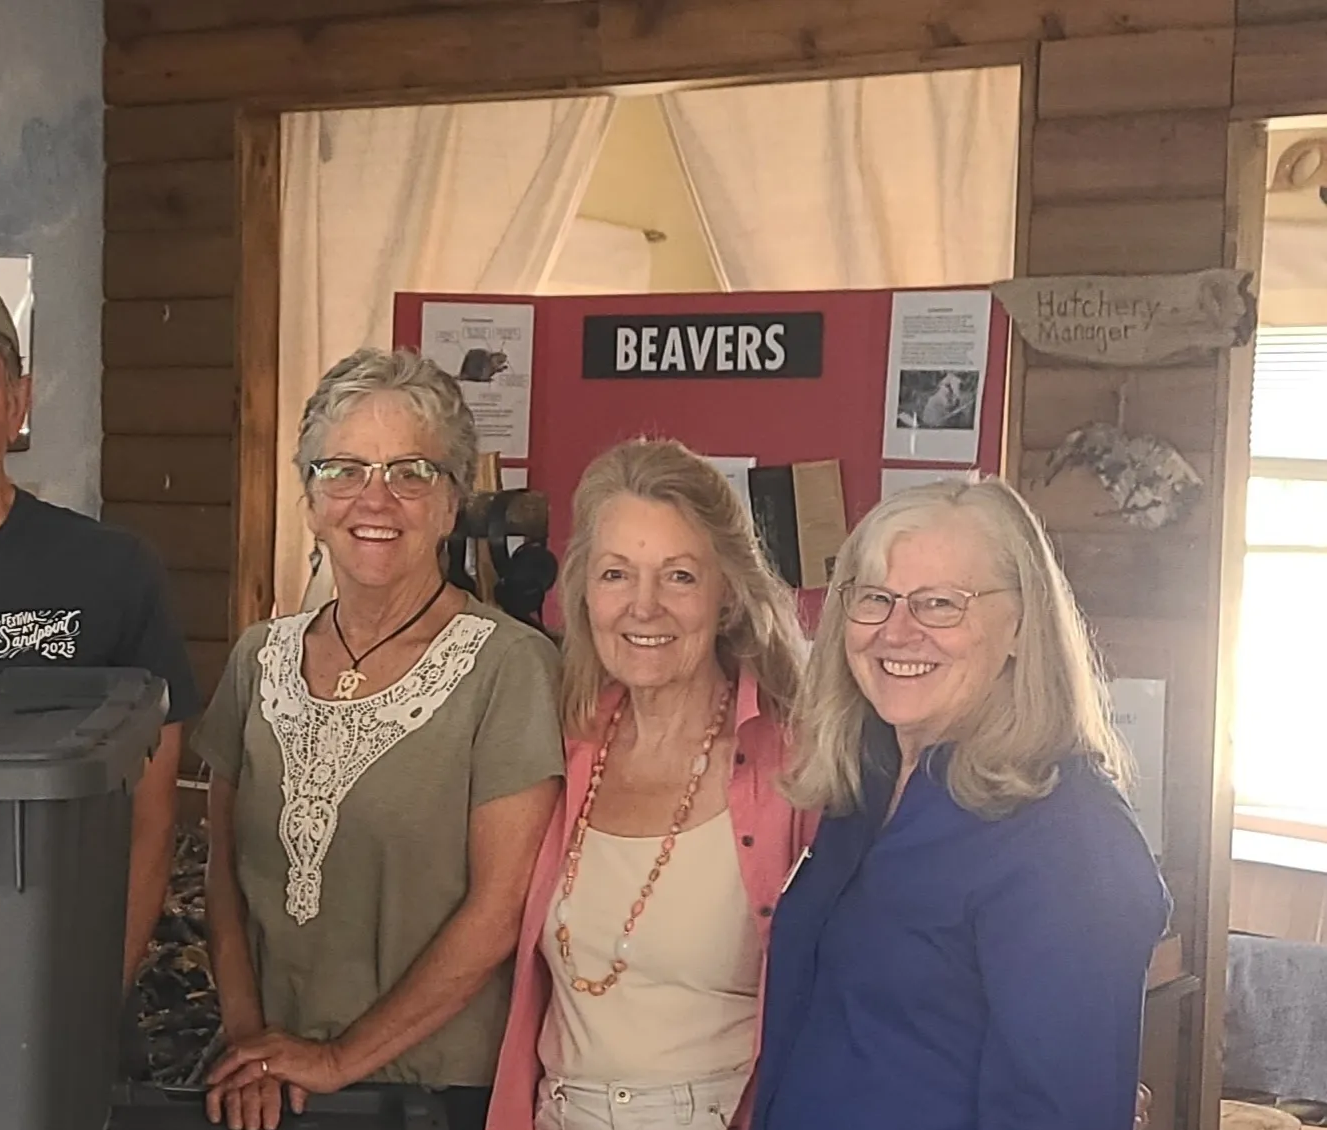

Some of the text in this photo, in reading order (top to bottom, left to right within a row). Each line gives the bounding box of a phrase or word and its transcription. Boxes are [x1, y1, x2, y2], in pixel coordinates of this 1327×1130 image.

[1036, 289, 1159, 330] Hatchery
[616, 323, 785, 371] BEAVERS
[1037, 322, 1136, 353] Manager
[22, 622, 34, 634] AT
[41, 640, 76, 659] 2025
